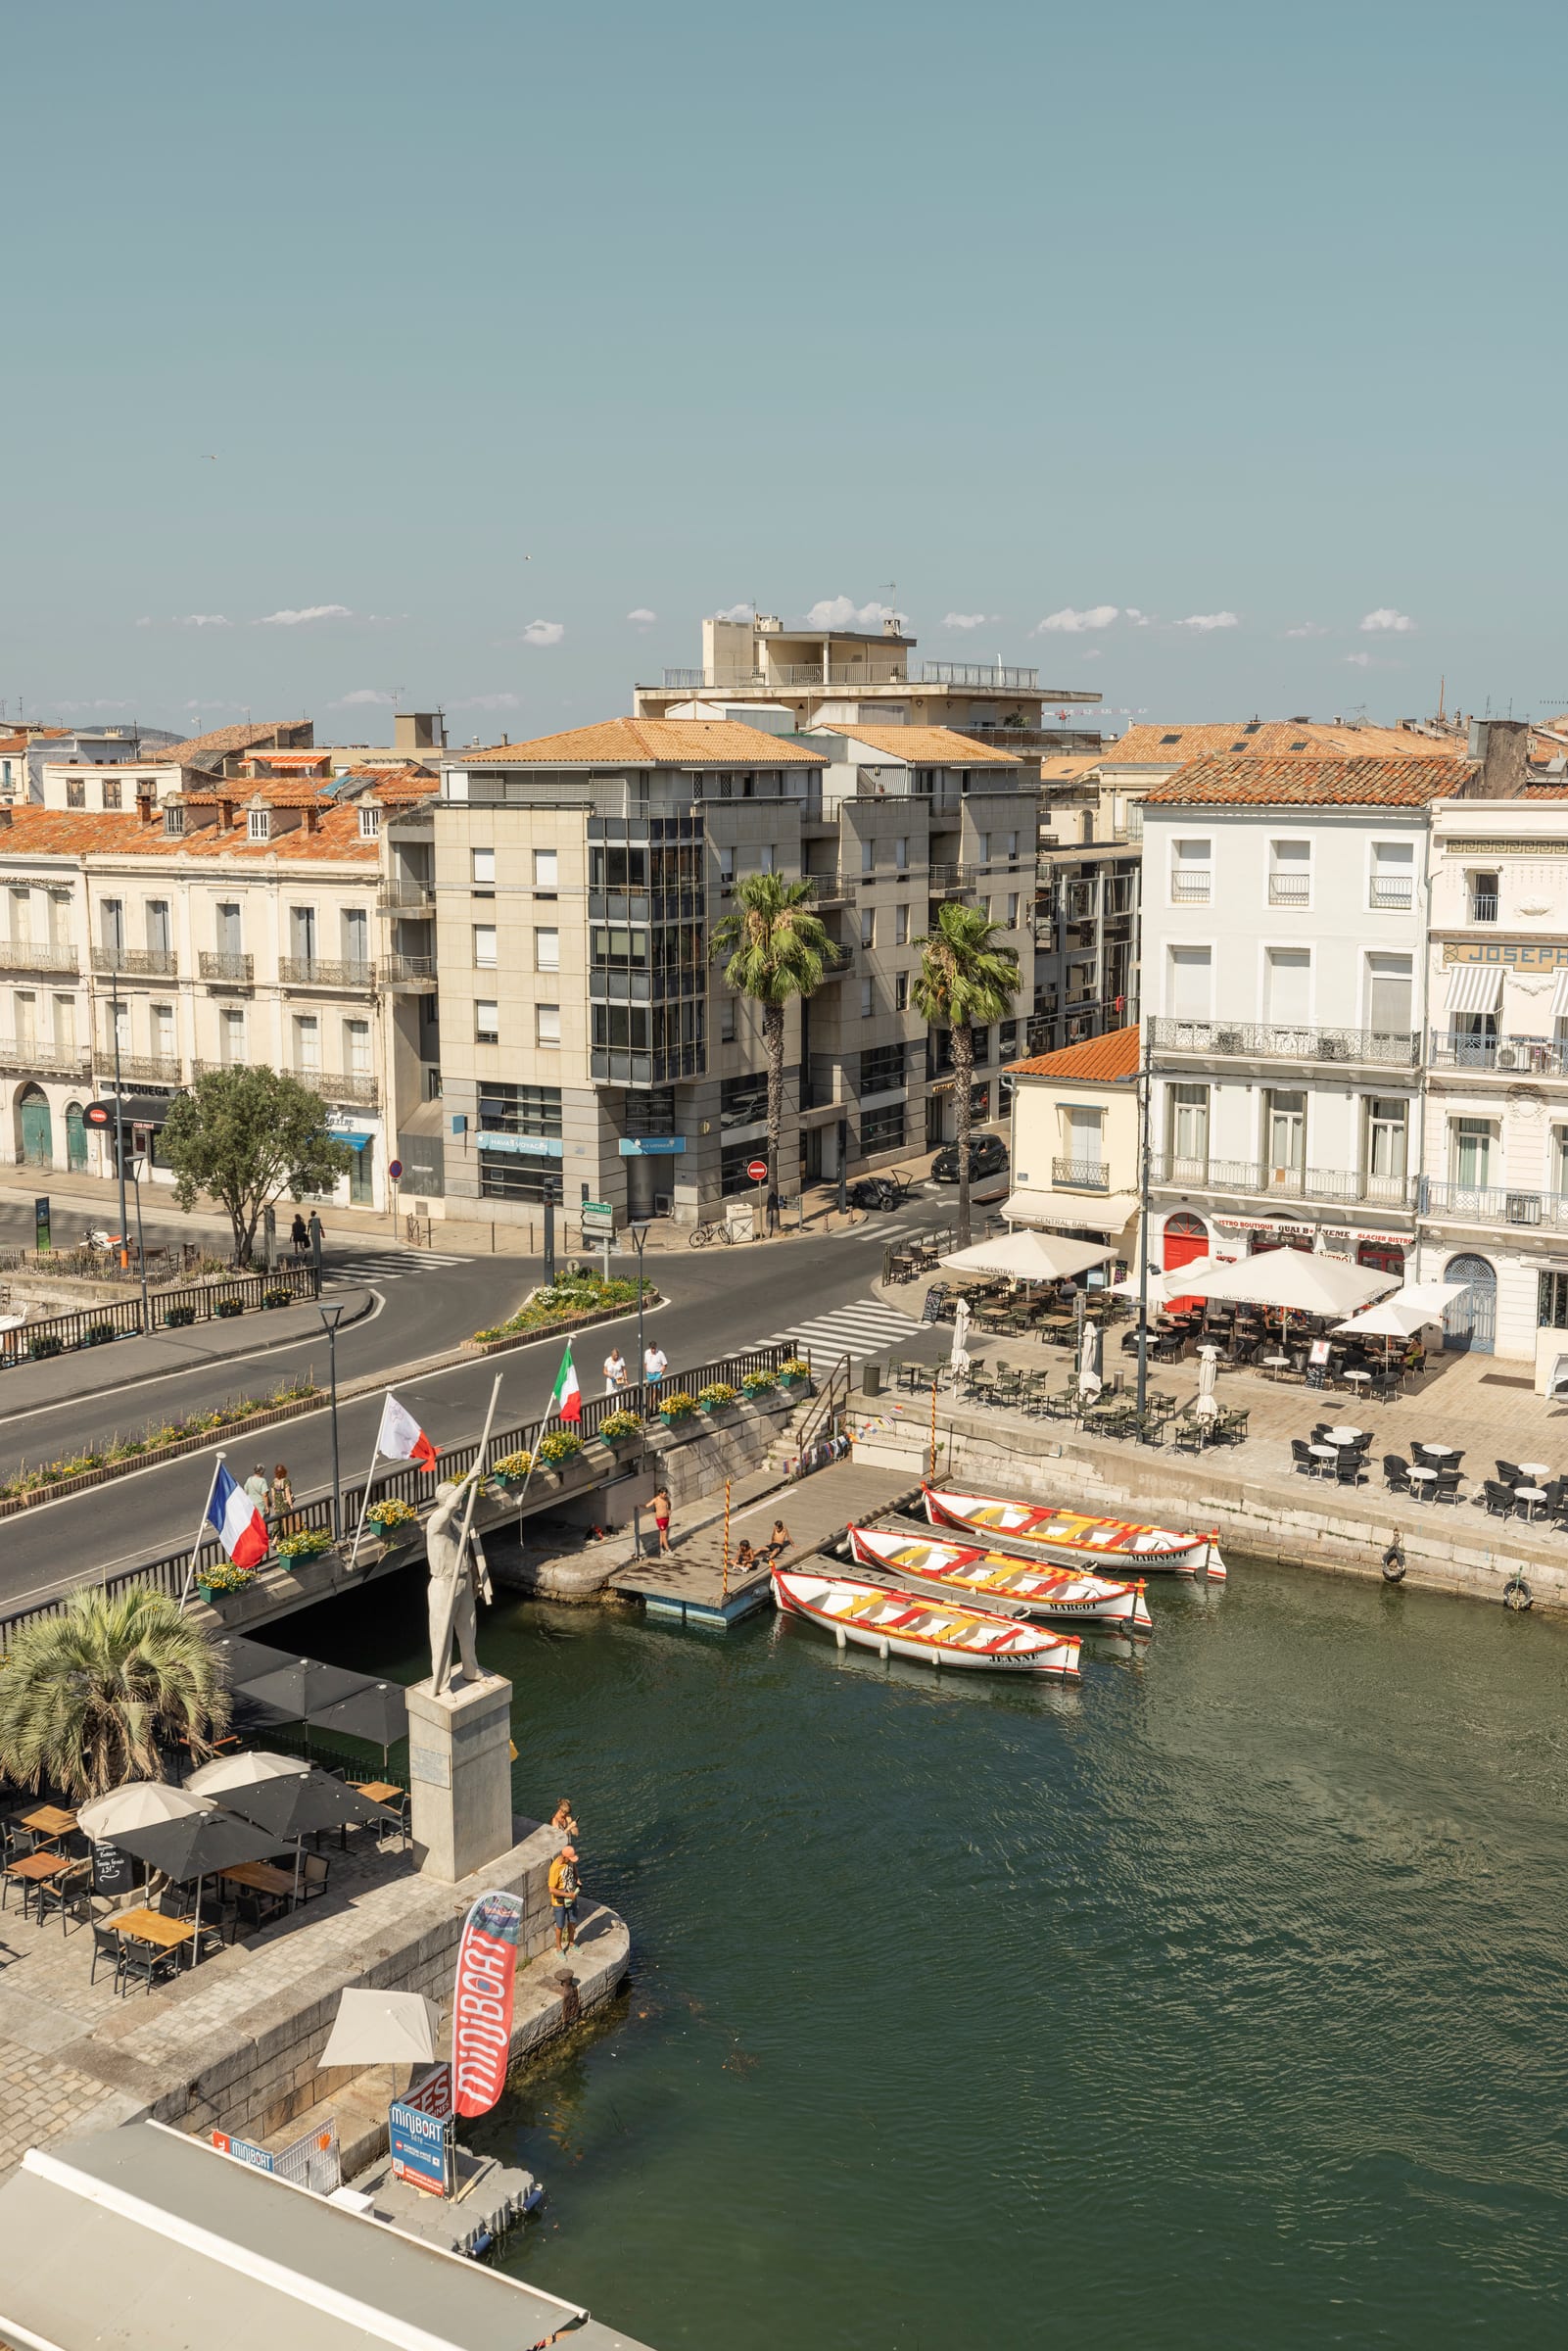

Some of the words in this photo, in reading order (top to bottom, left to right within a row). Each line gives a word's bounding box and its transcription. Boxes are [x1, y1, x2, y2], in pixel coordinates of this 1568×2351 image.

[1035, 1217, 1069, 1227] CENTRAL
[1240, 1222, 1273, 1230] BOUTIQUE
[1278, 1224, 1300, 1233] QUAI
[1357, 1233, 1386, 1242] GLACIER
[1132, 1550, 1190, 1561] MARINETTE
[1049, 1603, 1097, 1611] MARGOT
[989, 1652, 1039, 1662] JEANNE
